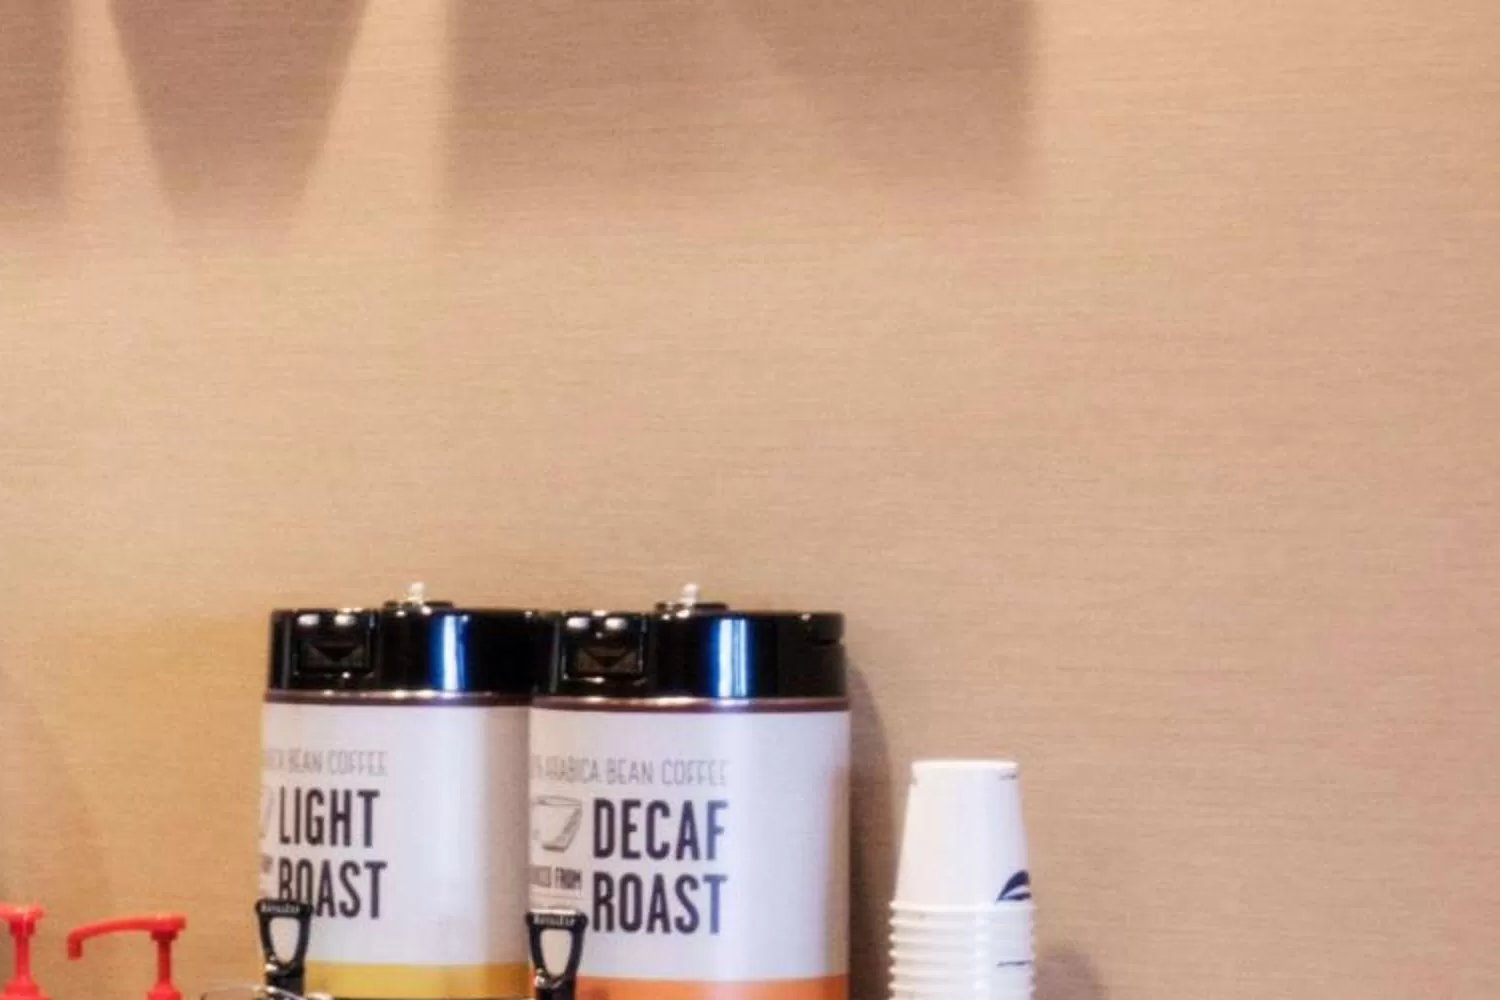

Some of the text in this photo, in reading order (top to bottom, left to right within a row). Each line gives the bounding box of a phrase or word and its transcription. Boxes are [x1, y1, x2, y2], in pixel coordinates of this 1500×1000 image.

[328, 750, 389, 776] COFFEE
[606, 757, 654, 785] BEAN
[661, 758, 729, 787] COFFEE
[279, 786, 380, 847] LIGHT
[593, 798, 728, 861] DECAF
[278, 857, 387, 919] ROAST
[592, 871, 728, 934] ROAST
